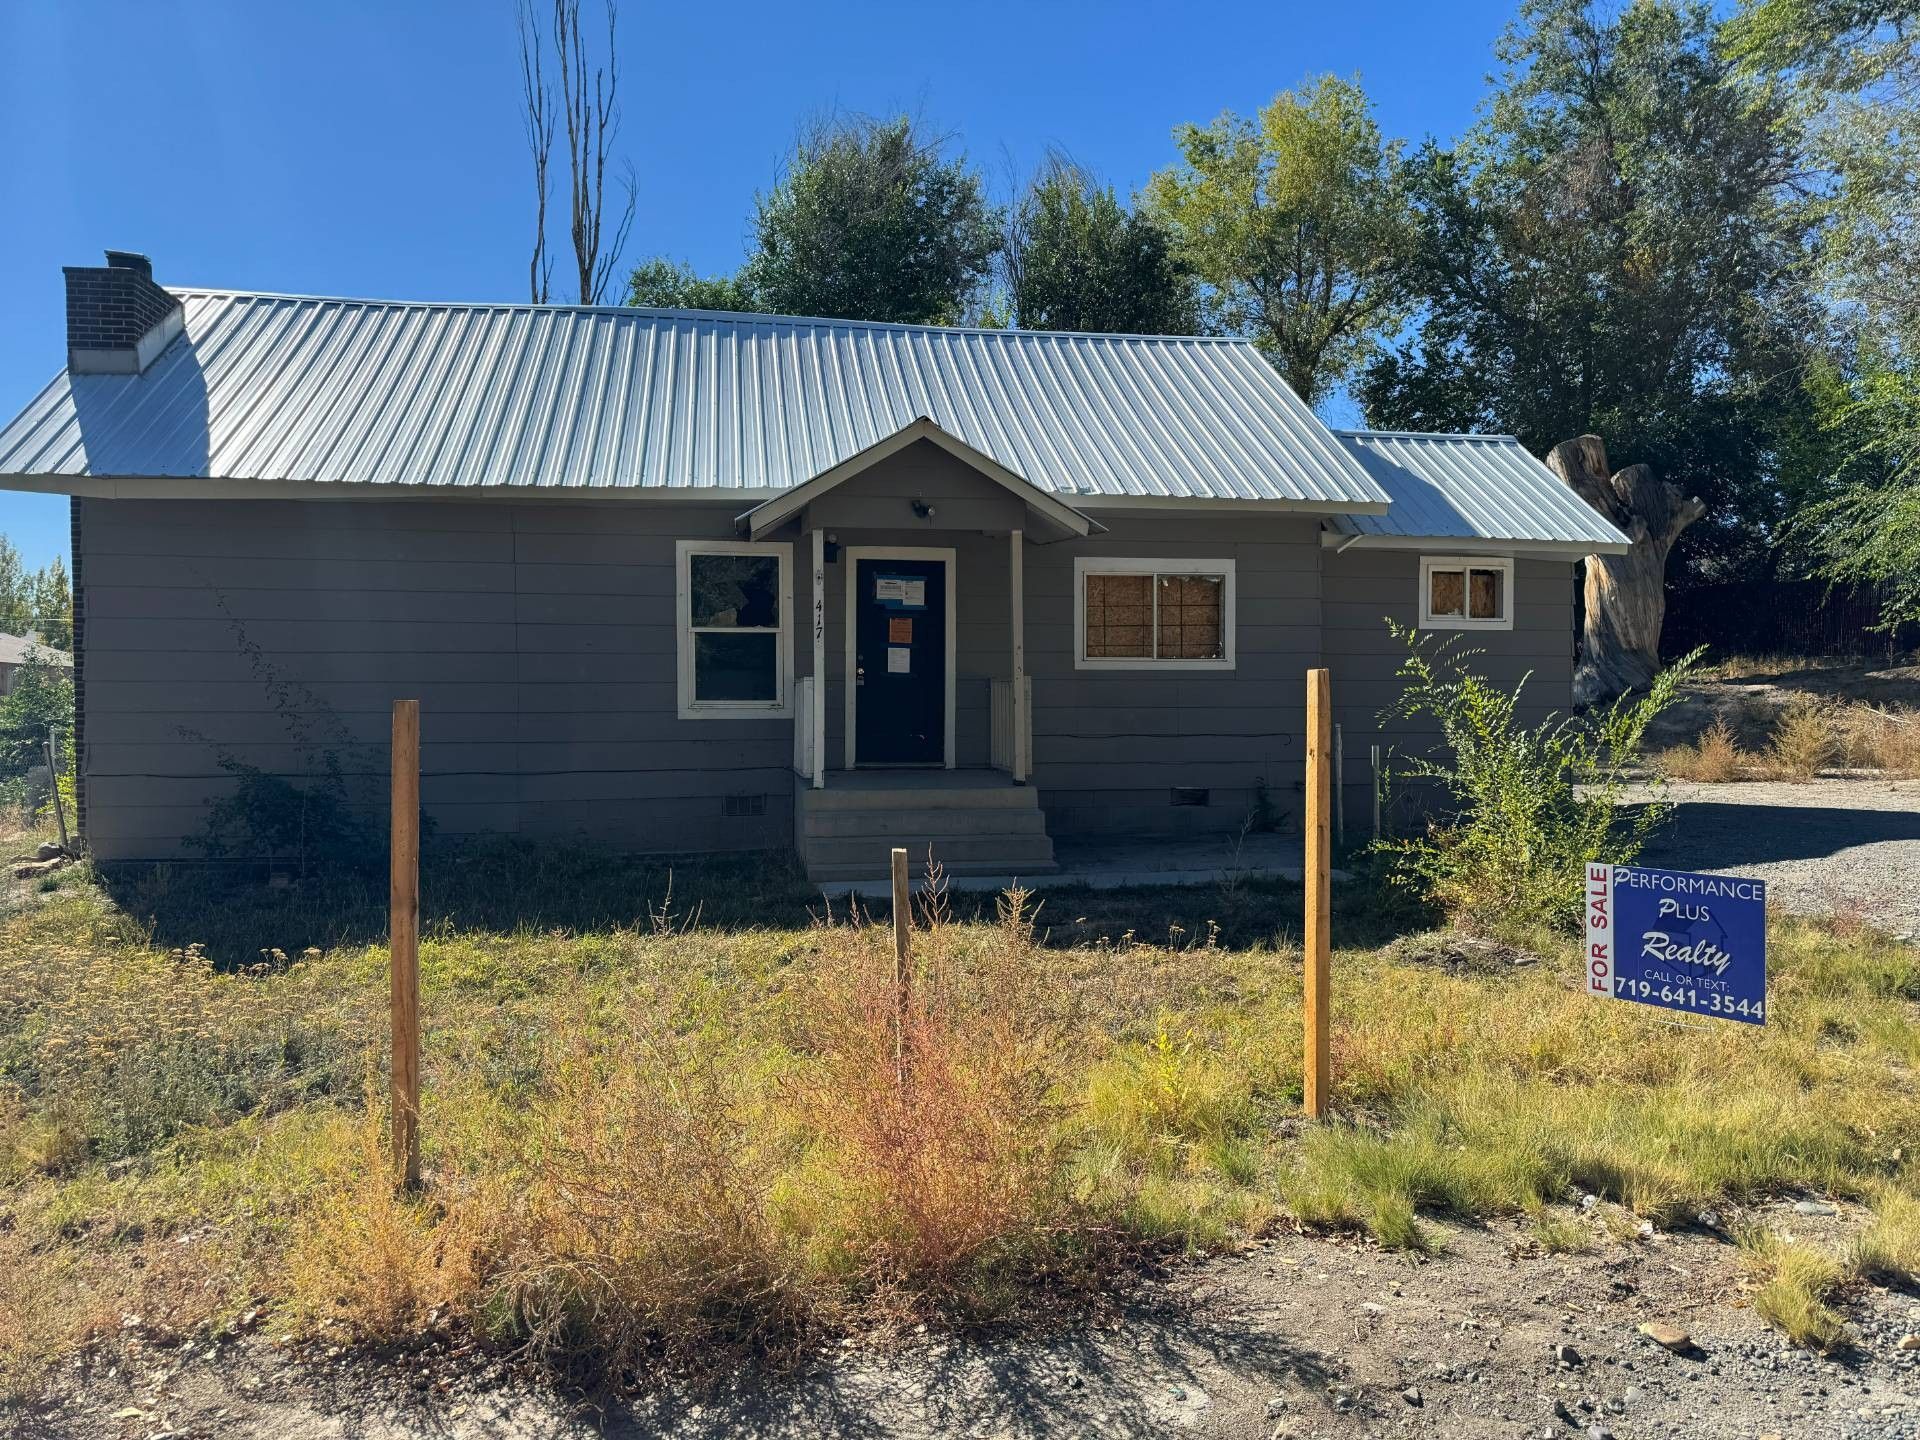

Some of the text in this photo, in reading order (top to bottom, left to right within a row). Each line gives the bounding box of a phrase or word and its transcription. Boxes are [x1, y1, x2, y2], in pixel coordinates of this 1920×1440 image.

[815, 600, 823, 639] 417
[1614, 868, 1763, 901] PERFORMANCE
[1658, 898, 1710, 921] PLUS
[1590, 867, 1608, 992] FOR SALE
[1640, 931, 1731, 976] Realty
[1615, 976, 1764, 1019] 719-641-3544
[1644, 969, 1730, 992] CALL OR TEXT:
